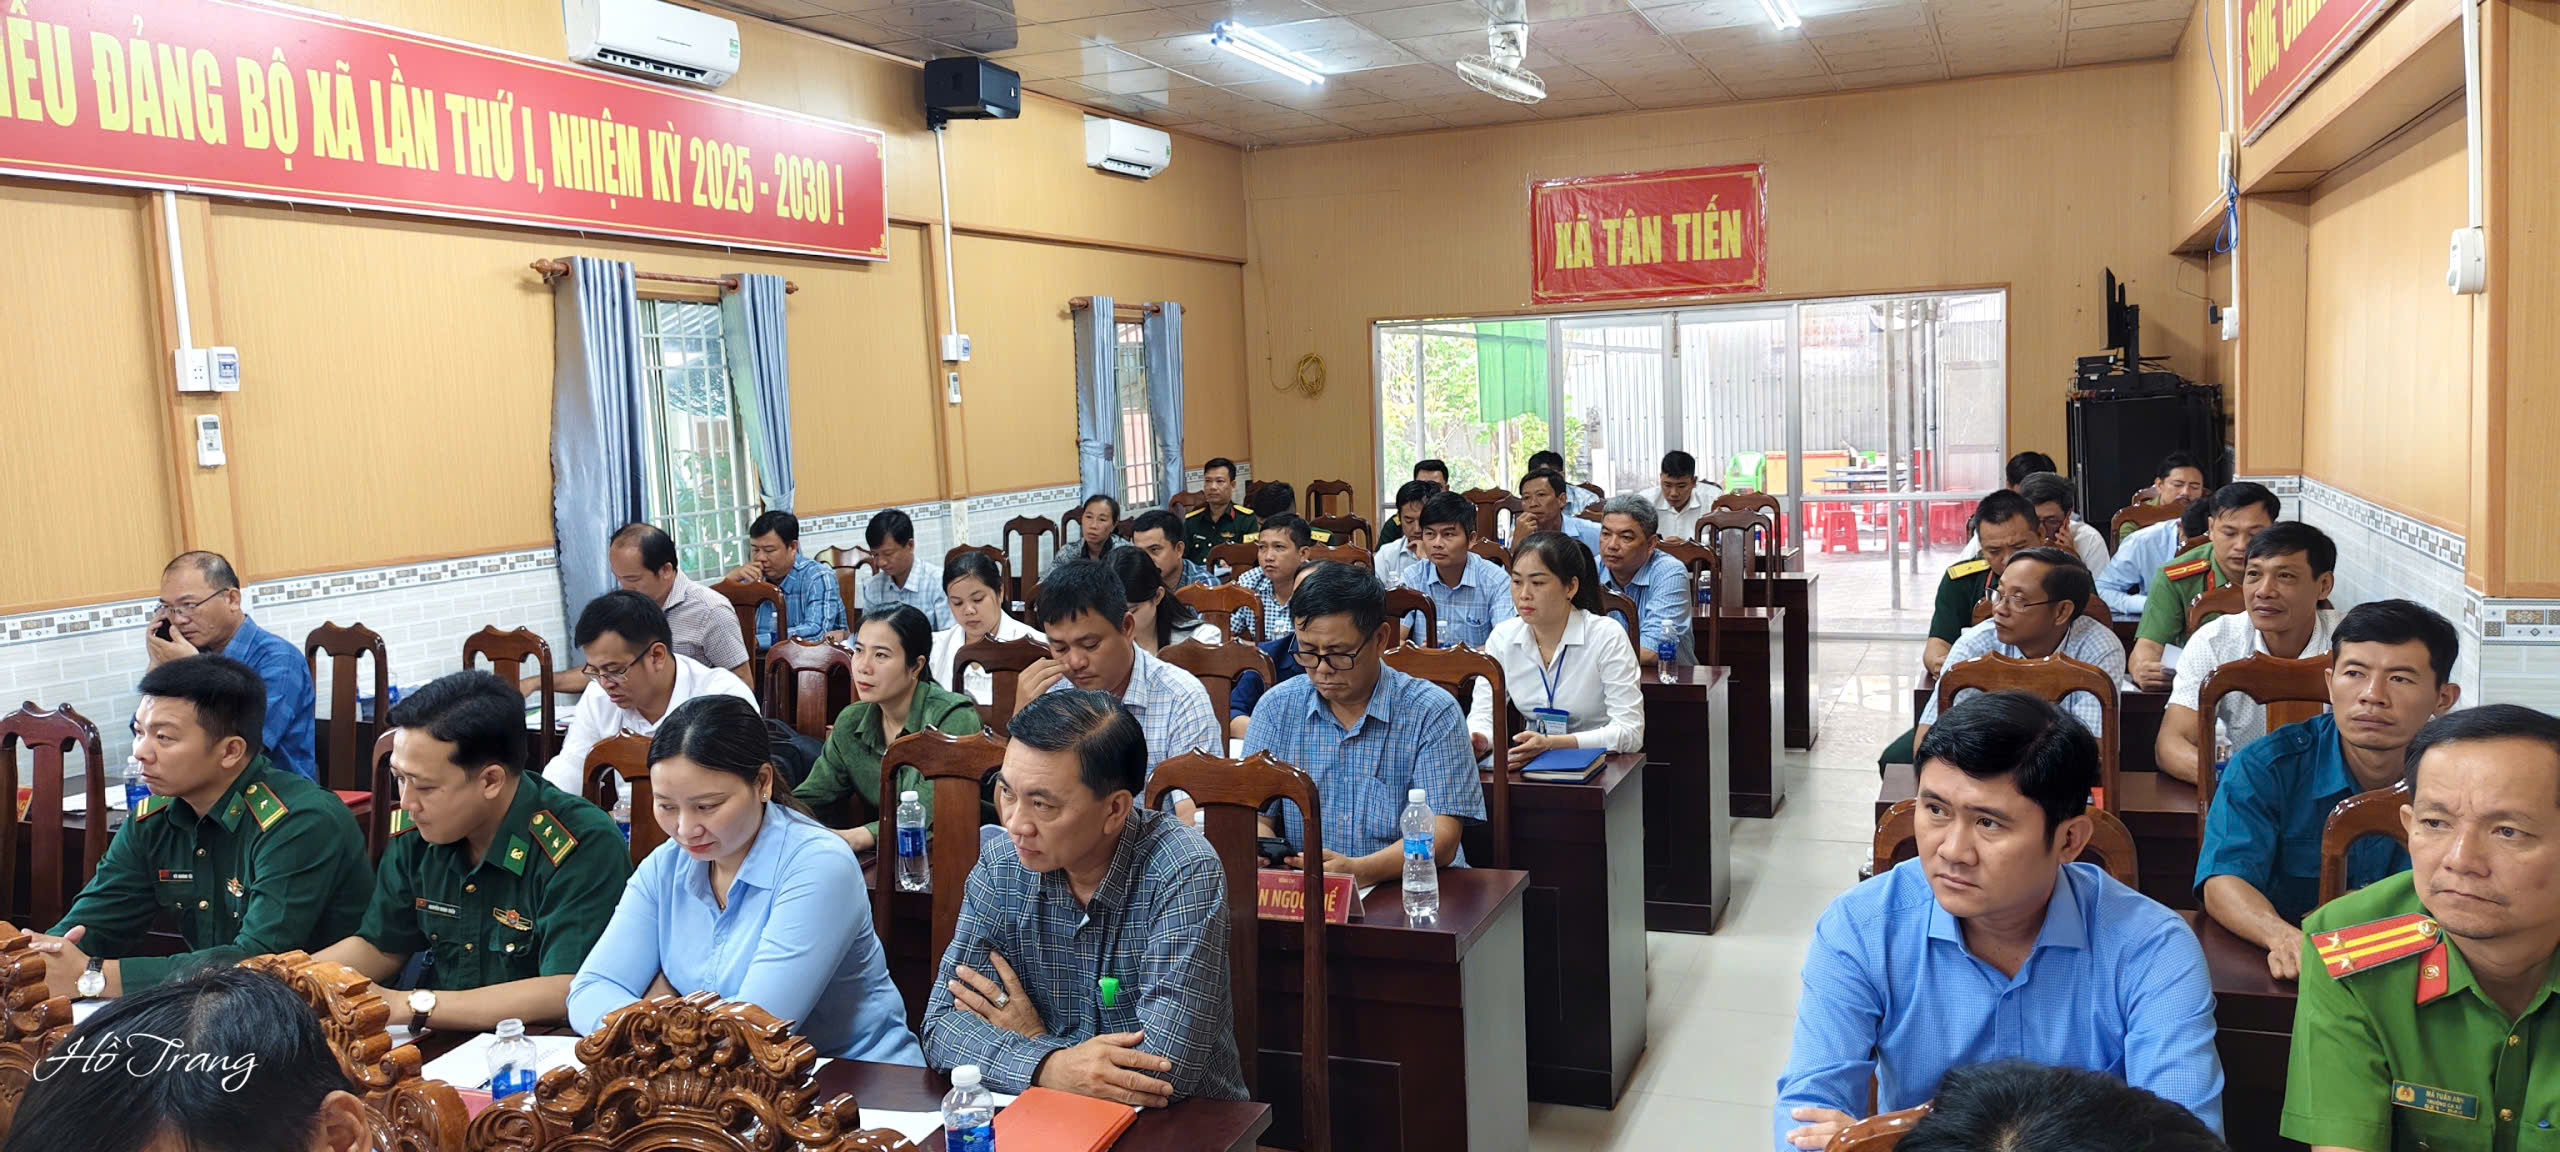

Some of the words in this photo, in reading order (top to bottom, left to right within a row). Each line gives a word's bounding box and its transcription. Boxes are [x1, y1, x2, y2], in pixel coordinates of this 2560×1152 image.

[90, 14, 227, 145] ĐẢNG
[236, 46, 298, 171] BỘ
[306, 59, 364, 162] XÃ
[370, 53, 439, 171] LẦN
[445, 88, 514, 182] THỨ
[521, 106, 543, 194] I,
[549, 107, 643, 209] NHIỆM
[648, 121, 682, 203] KỲ
[690, 137, 754, 214] 2025
[774, 153, 831, 224] 2030
[1555, 214, 1594, 270] XÃ
[1602, 208, 1662, 266] TÂN
[1672, 194, 1741, 262] TIẾN
